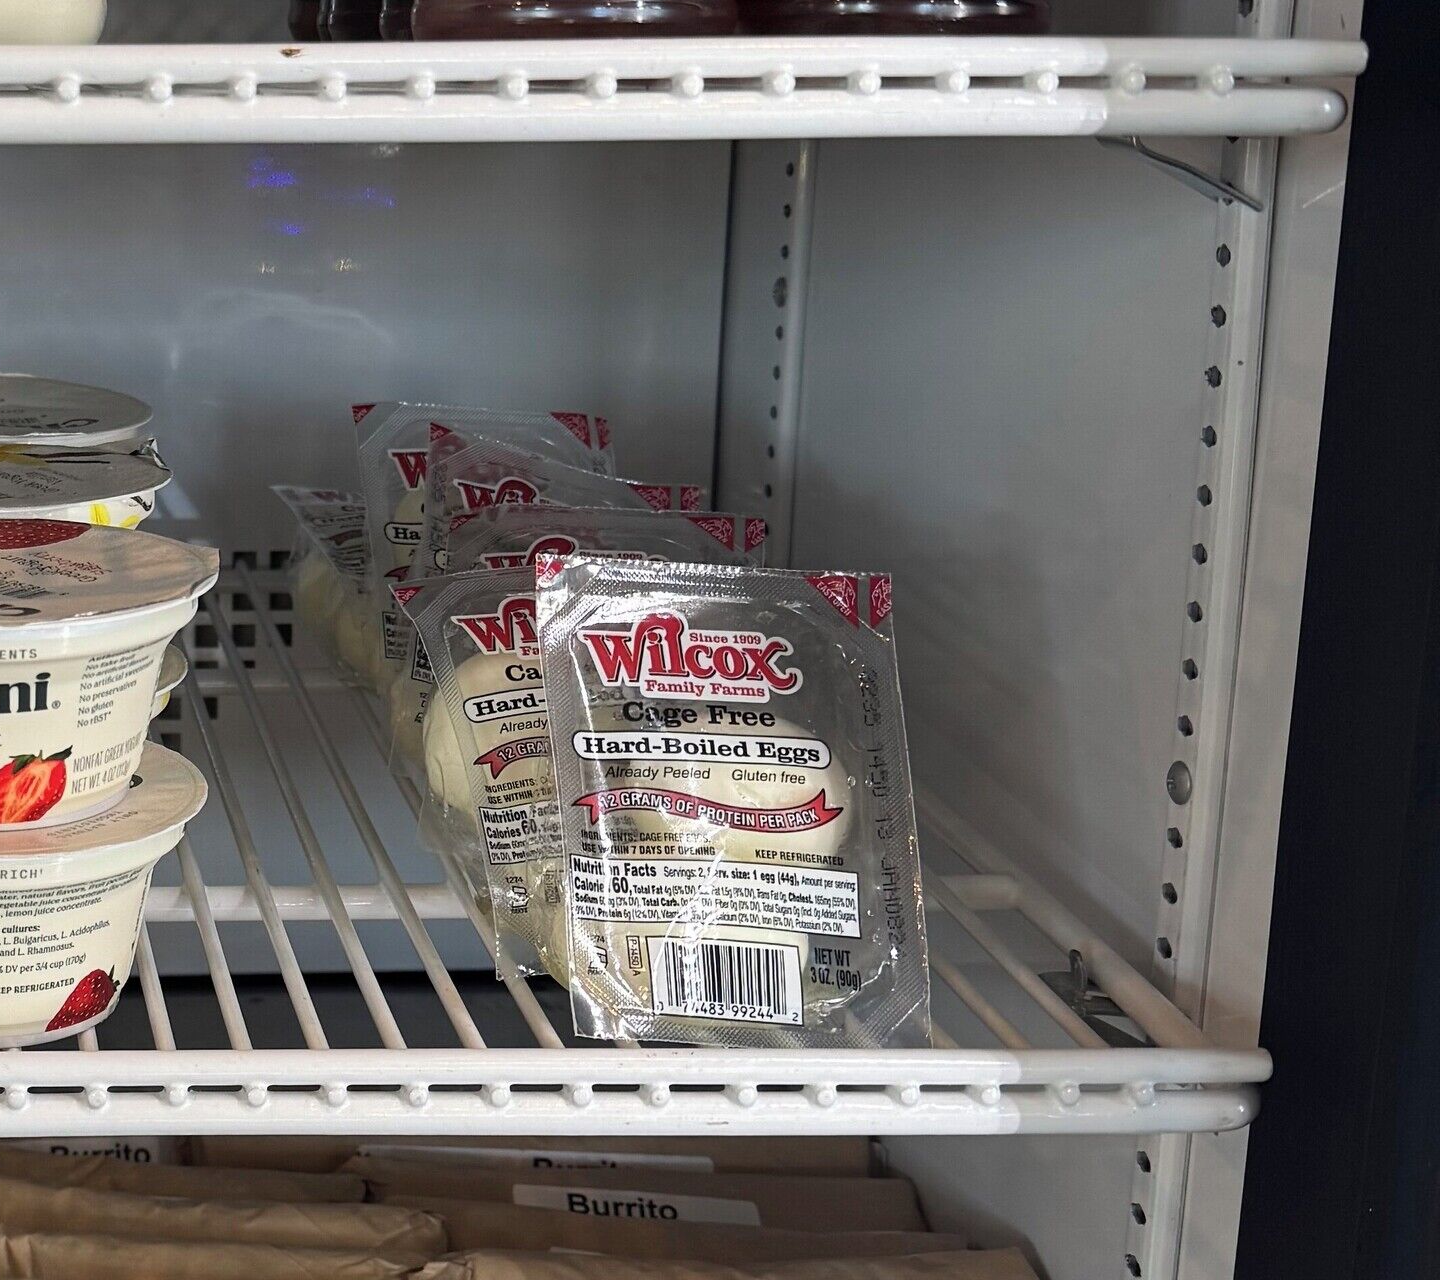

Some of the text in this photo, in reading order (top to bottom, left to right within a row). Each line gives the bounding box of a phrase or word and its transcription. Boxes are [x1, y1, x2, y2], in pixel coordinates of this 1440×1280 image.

[690, 632, 762, 646] Since 1909
[585, 613, 798, 691] Wilcox
[645, 679, 766, 698] Family Farms
[622, 701, 776, 727] Cage Free
[583, 736, 820, 765] Hard-Boiled Eggs
[605, 766, 711, 782] Already Peeled
[731, 768, 806, 785] Gluten free
[482, 808, 527, 824] Nutrition
[620, 793, 673, 813] GRAMS
[697, 804, 756, 829] PROTEIN
[759, 814, 786, 830] PER
[788, 807, 820, 828] PACK
[755, 849, 844, 866] KEEP REFRIGERATED
[624, 862, 657, 877] Facts
[1, 923, 41, 933] cultures:
[14, 977, 75, 994] REFRIGERATED
[567, 1192, 679, 1221] Burrito
